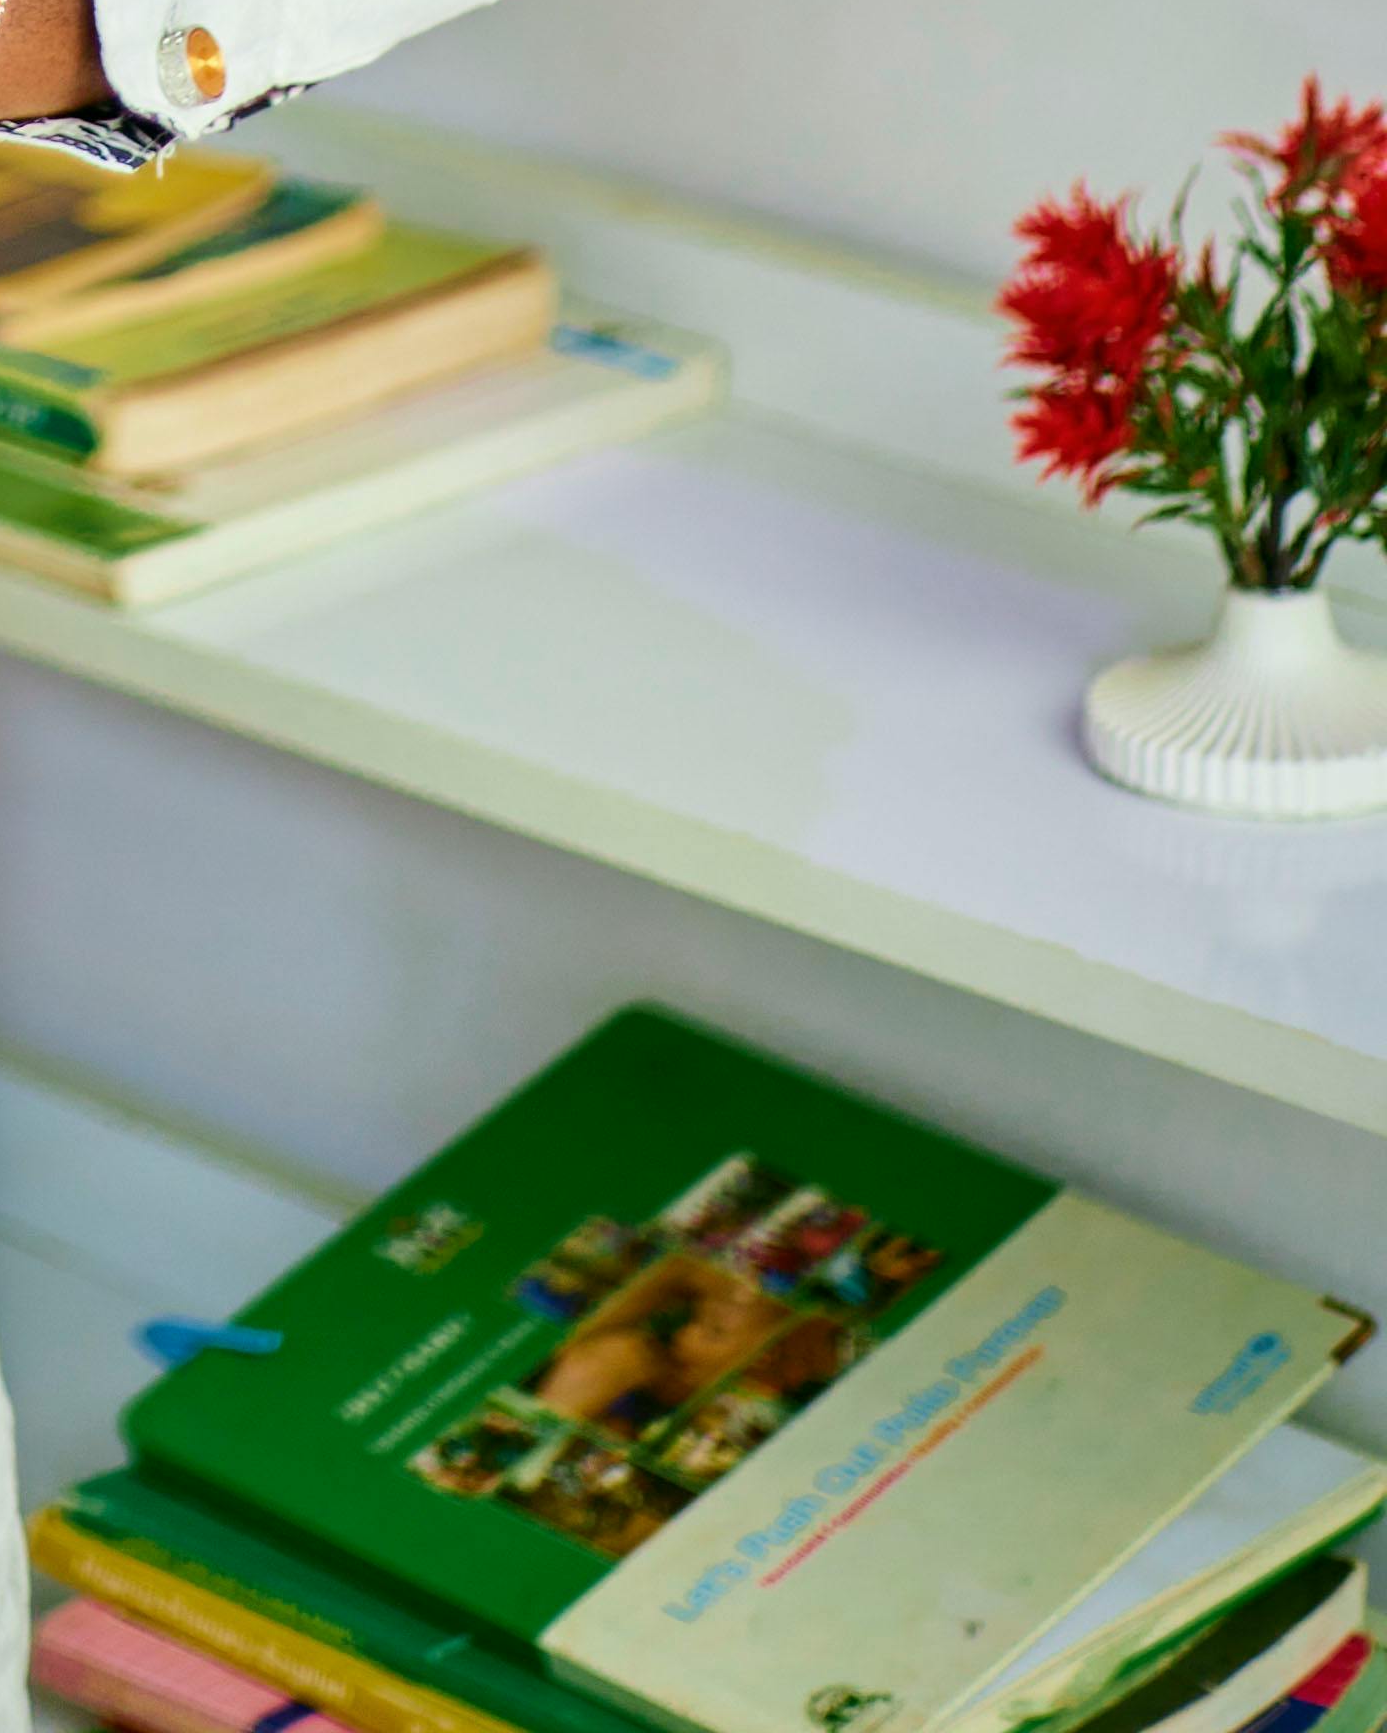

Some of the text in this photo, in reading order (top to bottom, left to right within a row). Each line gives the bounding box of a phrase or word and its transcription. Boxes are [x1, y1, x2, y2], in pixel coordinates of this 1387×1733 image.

[661, 1556, 752, 1623] Let's
[735, 1492, 828, 1563] Push
[812, 1442, 887, 1496] Out
